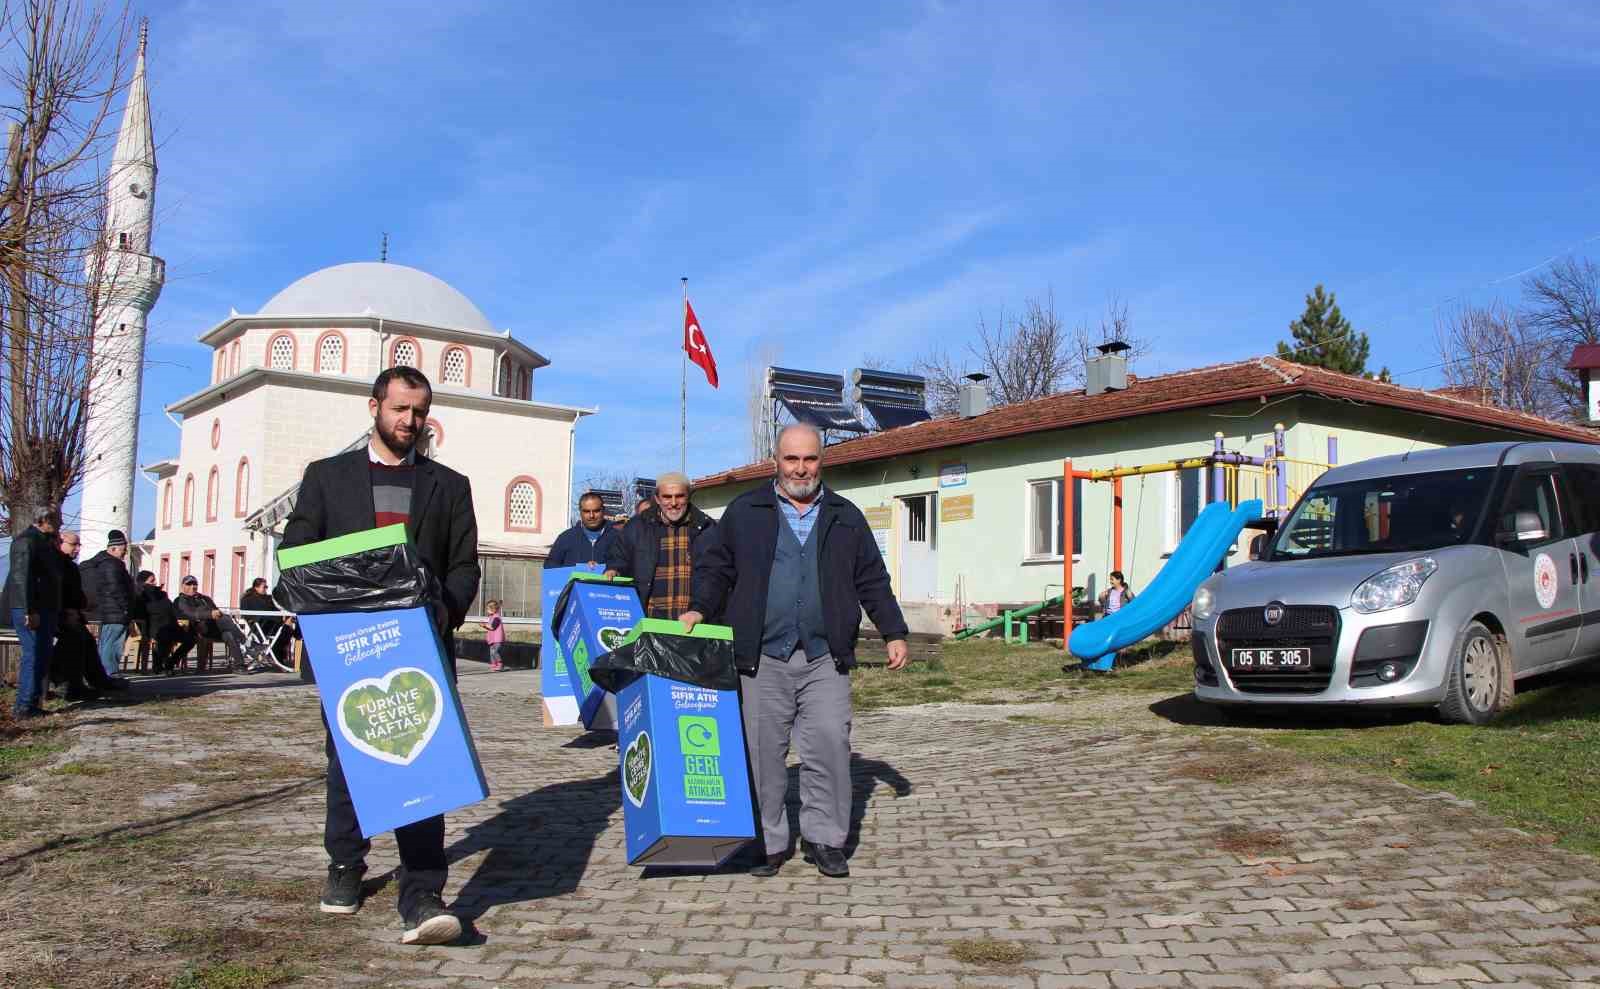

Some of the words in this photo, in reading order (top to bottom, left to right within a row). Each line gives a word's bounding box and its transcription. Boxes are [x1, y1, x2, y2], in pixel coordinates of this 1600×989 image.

[336, 636, 370, 655] SIFIR
[372, 625, 402, 645] ATIK
[1239, 651, 1253, 666] 05
[1260, 650, 1274, 665] RE
[1280, 650, 1302, 665] 305
[671, 691, 696, 701] SIFIR
[697, 694, 719, 703] ATIK
[364, 712, 427, 741] HAFTASI
[686, 755, 720, 777] GERİ
